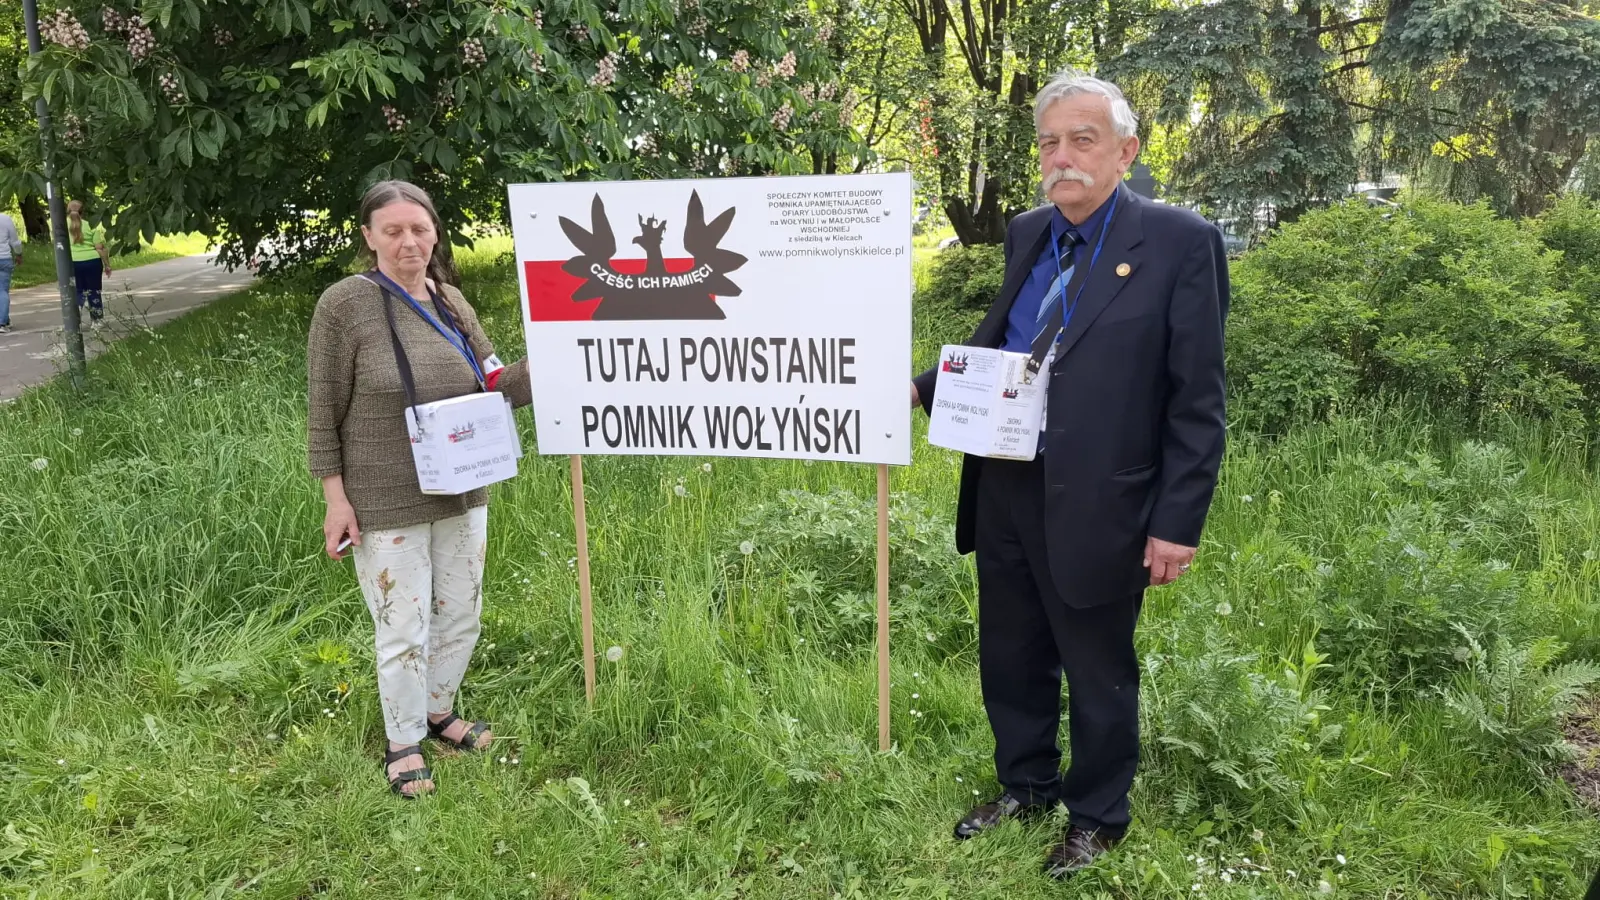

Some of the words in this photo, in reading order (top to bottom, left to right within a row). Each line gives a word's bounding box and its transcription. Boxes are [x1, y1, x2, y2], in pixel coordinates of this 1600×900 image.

[766, 192, 811, 200] SPOŁECZNY
[813, 191, 847, 199] KOMITET
[849, 189, 883, 198] BUDOWY
[804, 199, 882, 209] UPAMIĘTNIAJĄCEGO
[781, 209, 809, 217] OFIARY
[811, 207, 869, 216] LUDOBÓJSTWA
[828, 216, 881, 225] MAŁOPOLSCE
[800, 226, 850, 234] WSCHODNIEJ
[794, 235, 823, 243] siedzibą
[832, 234, 863, 242] Kielcach
[758, 245, 904, 259] www.pomnikwolynskikielce.pl
[590, 263, 634, 289] CZEŚĆ
[638, 277, 660, 289] ICH
[662, 263, 713, 288] PAMIĘCI
[577, 338, 669, 383] TUTAJ
[680, 336, 857, 385] POWSTANIE
[581, 404, 698, 449] POMNIK
[703, 394, 860, 455] WOŁYŃSKI
